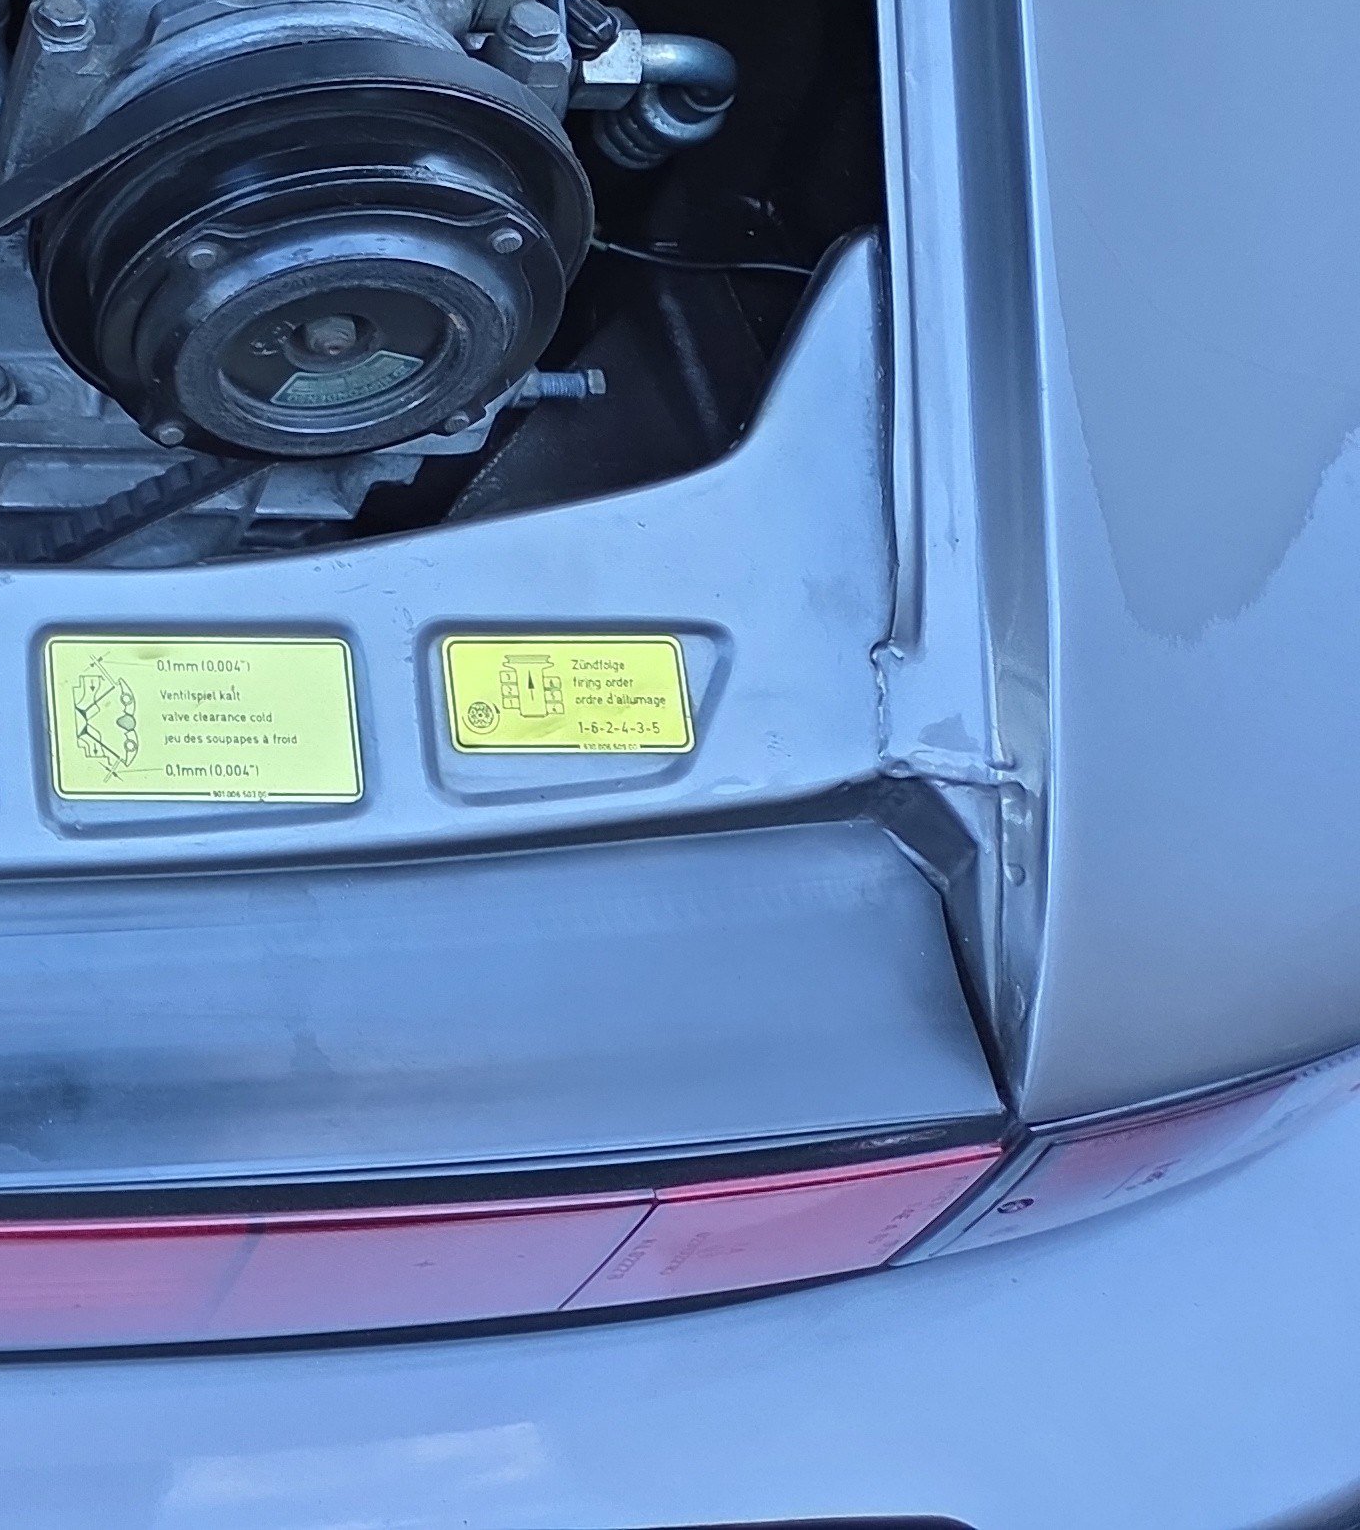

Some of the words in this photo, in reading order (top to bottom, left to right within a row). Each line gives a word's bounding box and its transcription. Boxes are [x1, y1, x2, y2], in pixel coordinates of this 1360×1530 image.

[571, 659, 625, 673] Zündfolge
[573, 676, 602, 690] firing
[605, 677, 634, 688] order
[160, 689, 217, 705] Ventilspiel
[219, 688, 241, 701] kalt
[575, 694, 603, 705] ordre
[606, 692, 666, 708] d'allumage
[161, 711, 190, 722] valve
[193, 711, 247, 723] clearance
[249, 711, 273, 723] cold
[578, 721, 660, 734] 1-6-2-4-3-5
[164, 734, 181, 746] jeu
[184, 733, 203, 745] des
[205, 734, 259, 746] soupapes
[262, 734, 269, 745] à
[273, 733, 298, 745] froid
